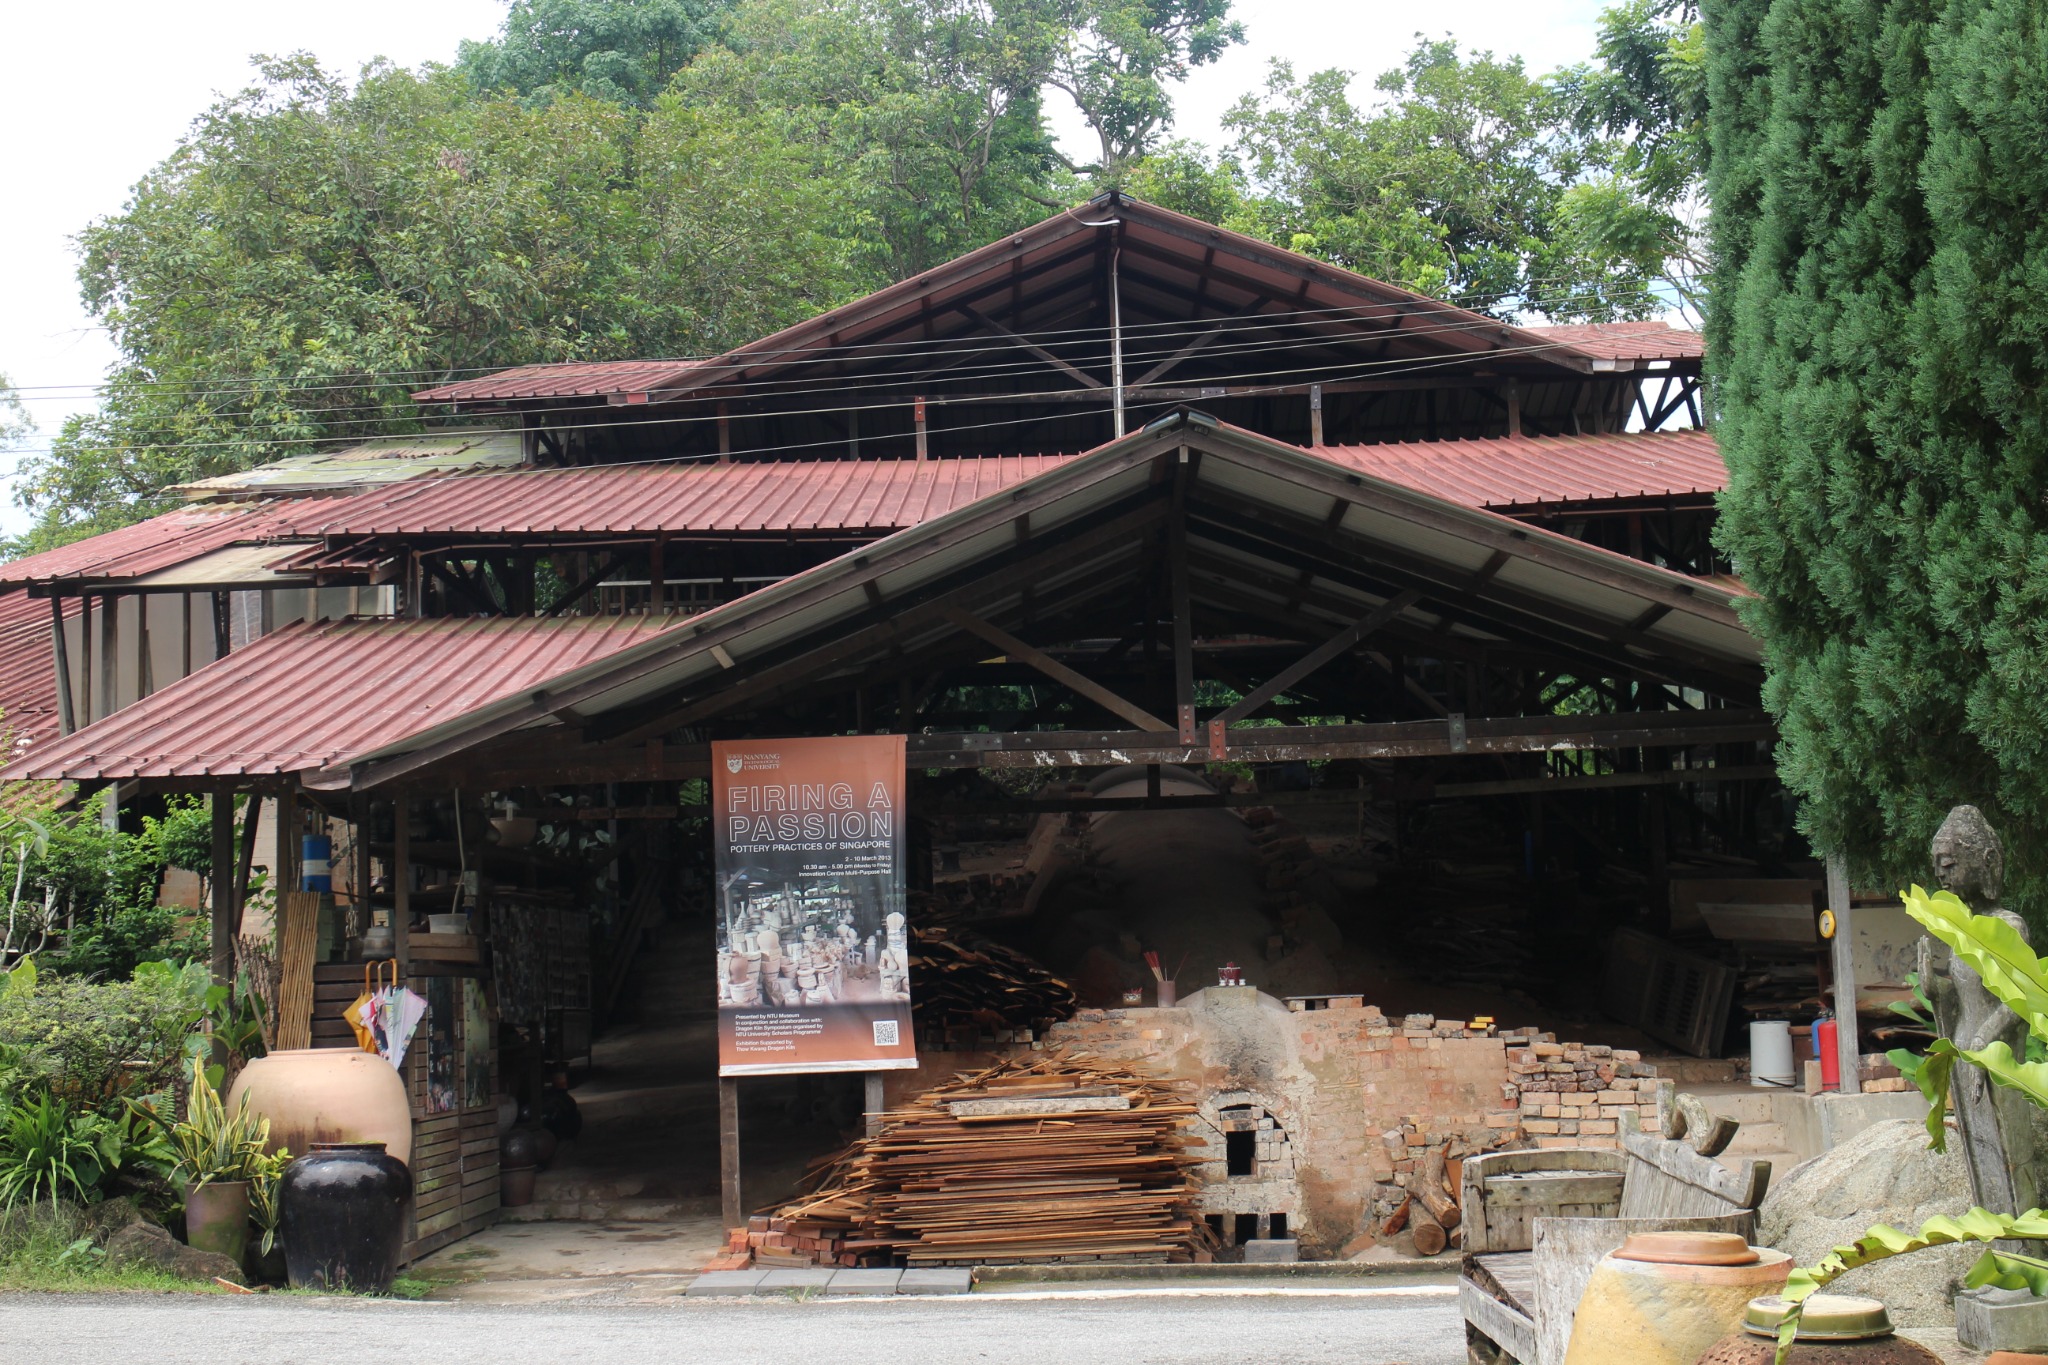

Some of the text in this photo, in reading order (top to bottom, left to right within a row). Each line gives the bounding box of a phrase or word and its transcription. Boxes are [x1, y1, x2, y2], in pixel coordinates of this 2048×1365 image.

[728, 782, 892, 813] FIRING A
[729, 811, 892, 843] PASSION
[730, 840, 891, 853] POTTERY PRACTICES OF SINGAPORE
